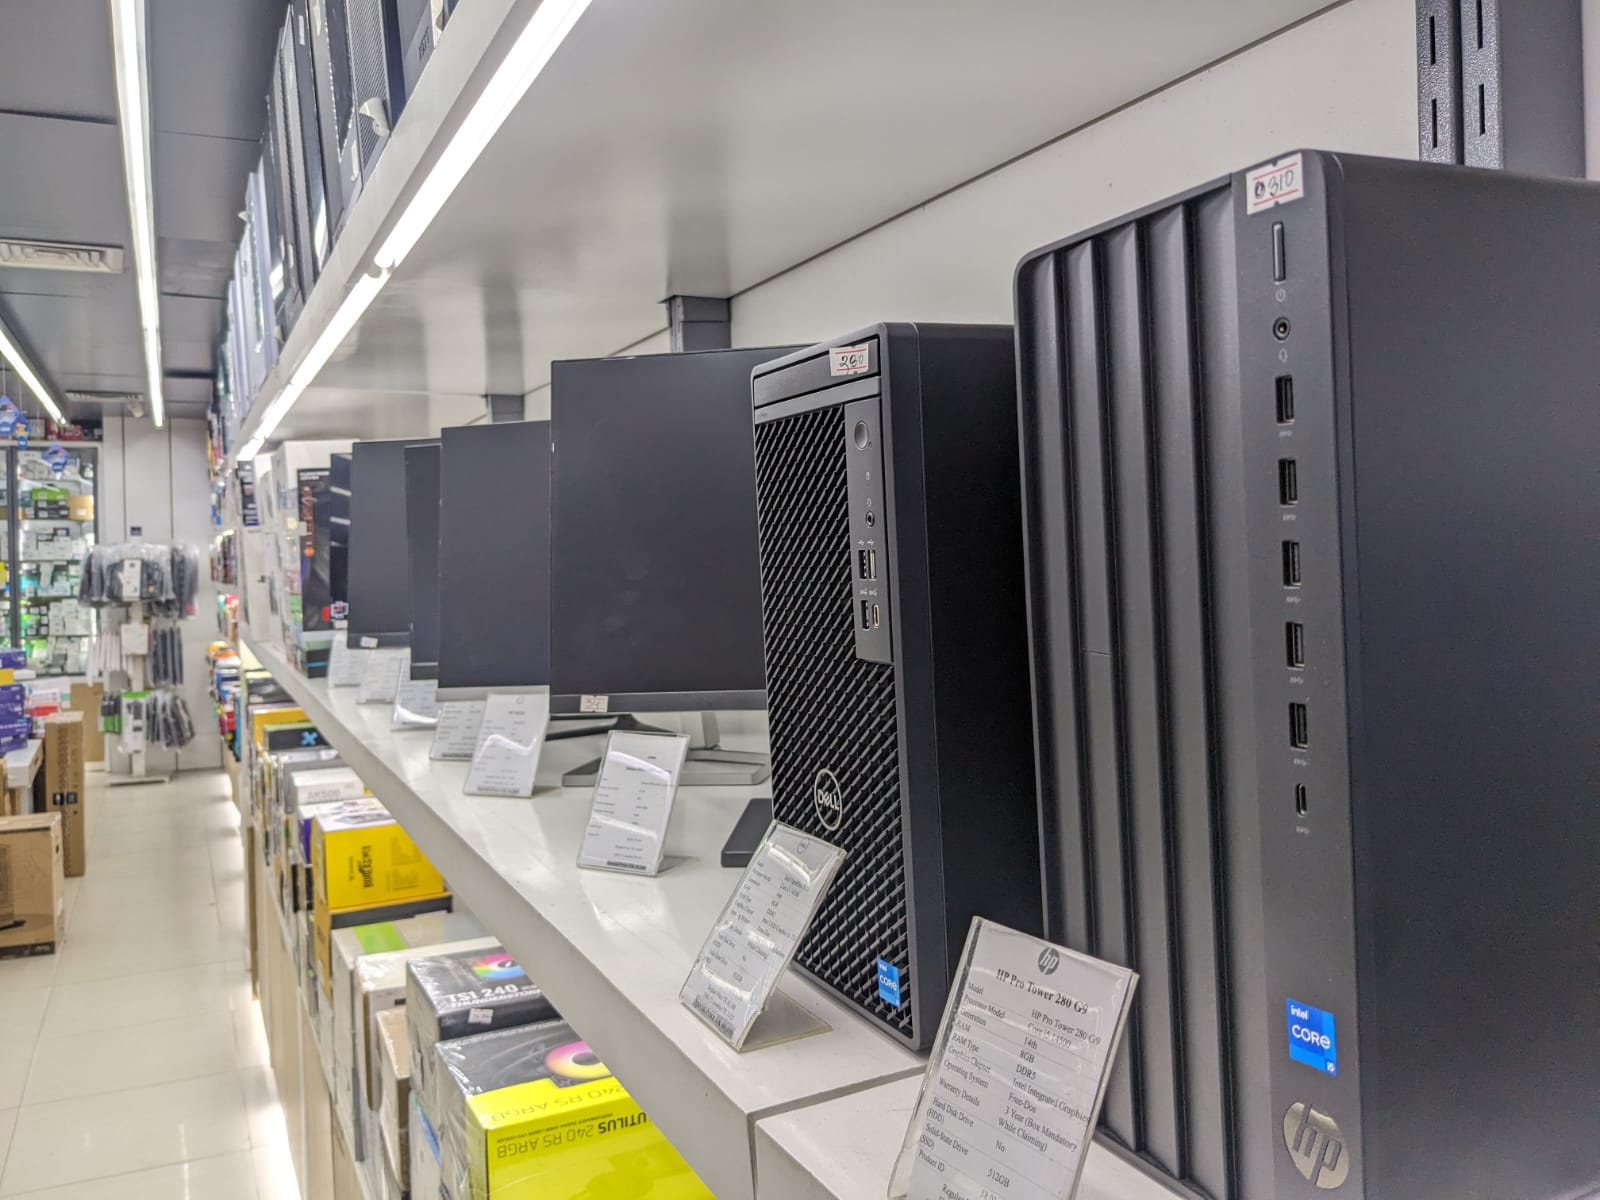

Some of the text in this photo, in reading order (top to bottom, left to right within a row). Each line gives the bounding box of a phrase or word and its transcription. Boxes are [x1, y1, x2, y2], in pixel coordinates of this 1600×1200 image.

[818, 789, 840, 811] DELL
[1039, 947, 1060, 975] hp
[480, 983, 519, 998] 240
[967, 982, 984, 996] Model
[996, 968, 1089, 1016] HP Pro Tower 280 G9
[988, 1005, 1005, 1019] Model
[1290, 1004, 1309, 1020] intel
[1031, 1009, 1101, 1046] HP Pro Tower 280 G9
[951, 1031, 979, 1053] RAM Type
[1024, 1036, 1038, 1050] 14th
[1019, 1050, 1035, 1064] 8GB
[1326, 1060, 1335, 1073] i5
[944, 1058, 989, 1089] Operating System
[1015, 1063, 1037, 1081] DDR5
[961, 1090, 981, 1107] Details
[1008, 1091, 1037, 1114] Free-Dos
[1012, 1077, 1027, 1091] Intel
[1027, 1084, 1059, 1108] Integrated
[926, 1107, 945, 1125] (HDD)
[932, 1096, 975, 1128] Hard Disk Drive
[598, 1111, 648, 1135] UTILUS
[1004, 1105, 1078, 1153] 3 Year (Box Mandatory
[543, 1132, 563, 1149] RS
[566, 1124, 595, 1143] 240
[920, 1134, 935, 1151] (SSD)
[998, 1116, 1048, 1153] While Claiming)
[496, 1138, 539, 1160] ARGB
[952, 1140, 969, 1157] Drive
[995, 1139, 1006, 1153] No
[1288, 1102, 1346, 1187] hp
[918, 1149, 945, 1173] Product ID
[987, 1168, 1010, 1188] 512GB
